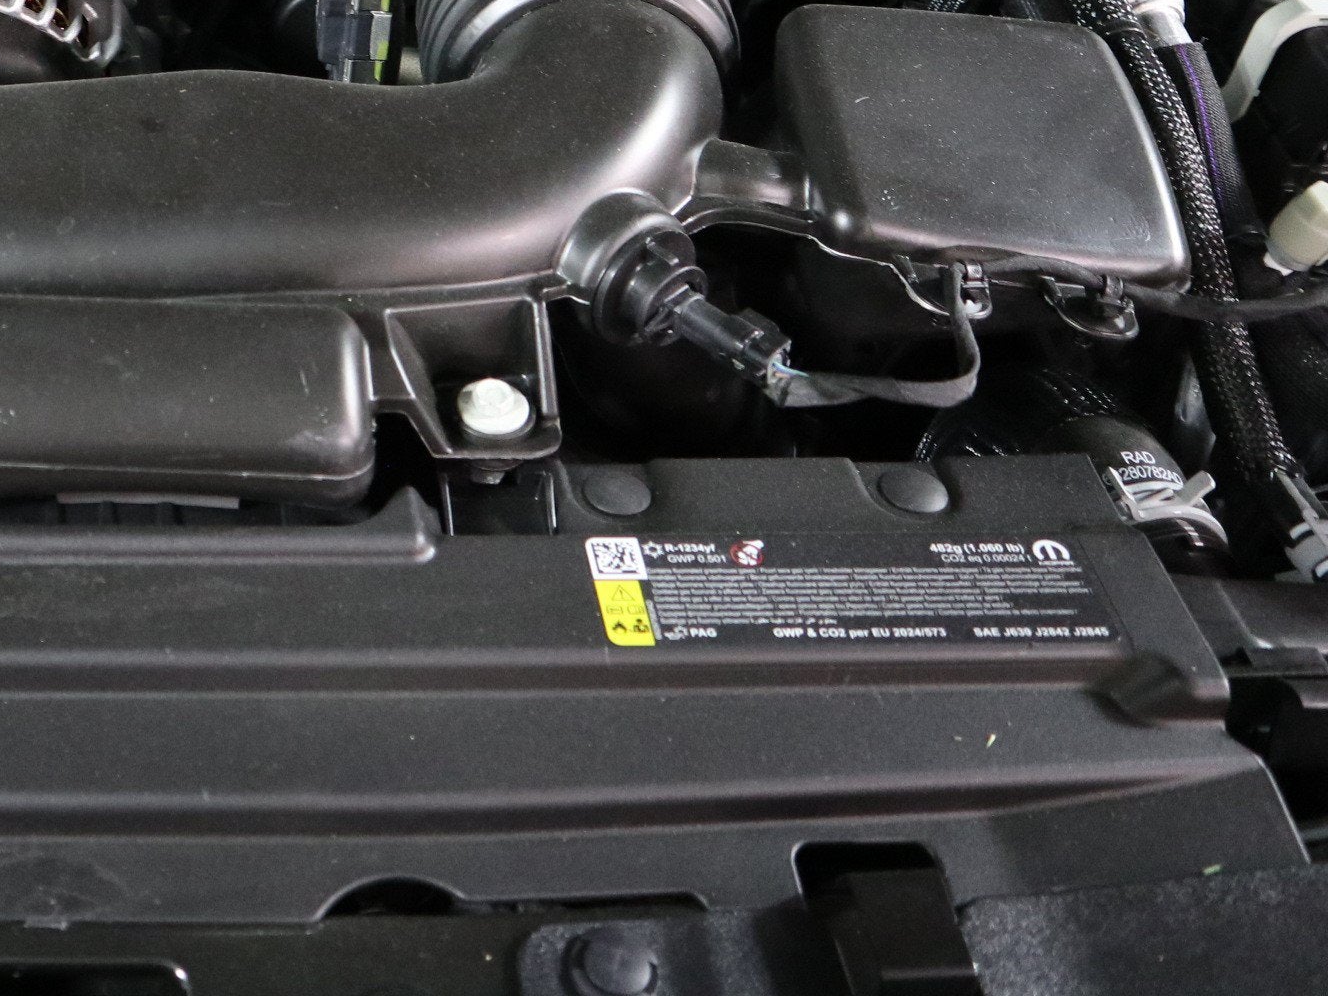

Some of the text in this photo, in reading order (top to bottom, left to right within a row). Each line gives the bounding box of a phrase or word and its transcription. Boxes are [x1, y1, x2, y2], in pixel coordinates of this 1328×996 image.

[1120, 451, 1156, 464] RAD
[664, 543, 716, 554] R-1234yf
[929, 542, 1025, 554] 482g (1.060 lb)
[667, 555, 727, 564] GWP 0.501
[941, 554, 967, 563] CO2
[968, 555, 983, 564] eq
[690, 628, 718, 638] PAG
[773, 627, 947, 640] GWP & CO2 per EU 2024/573
[973, 627, 1001, 638] SAE
